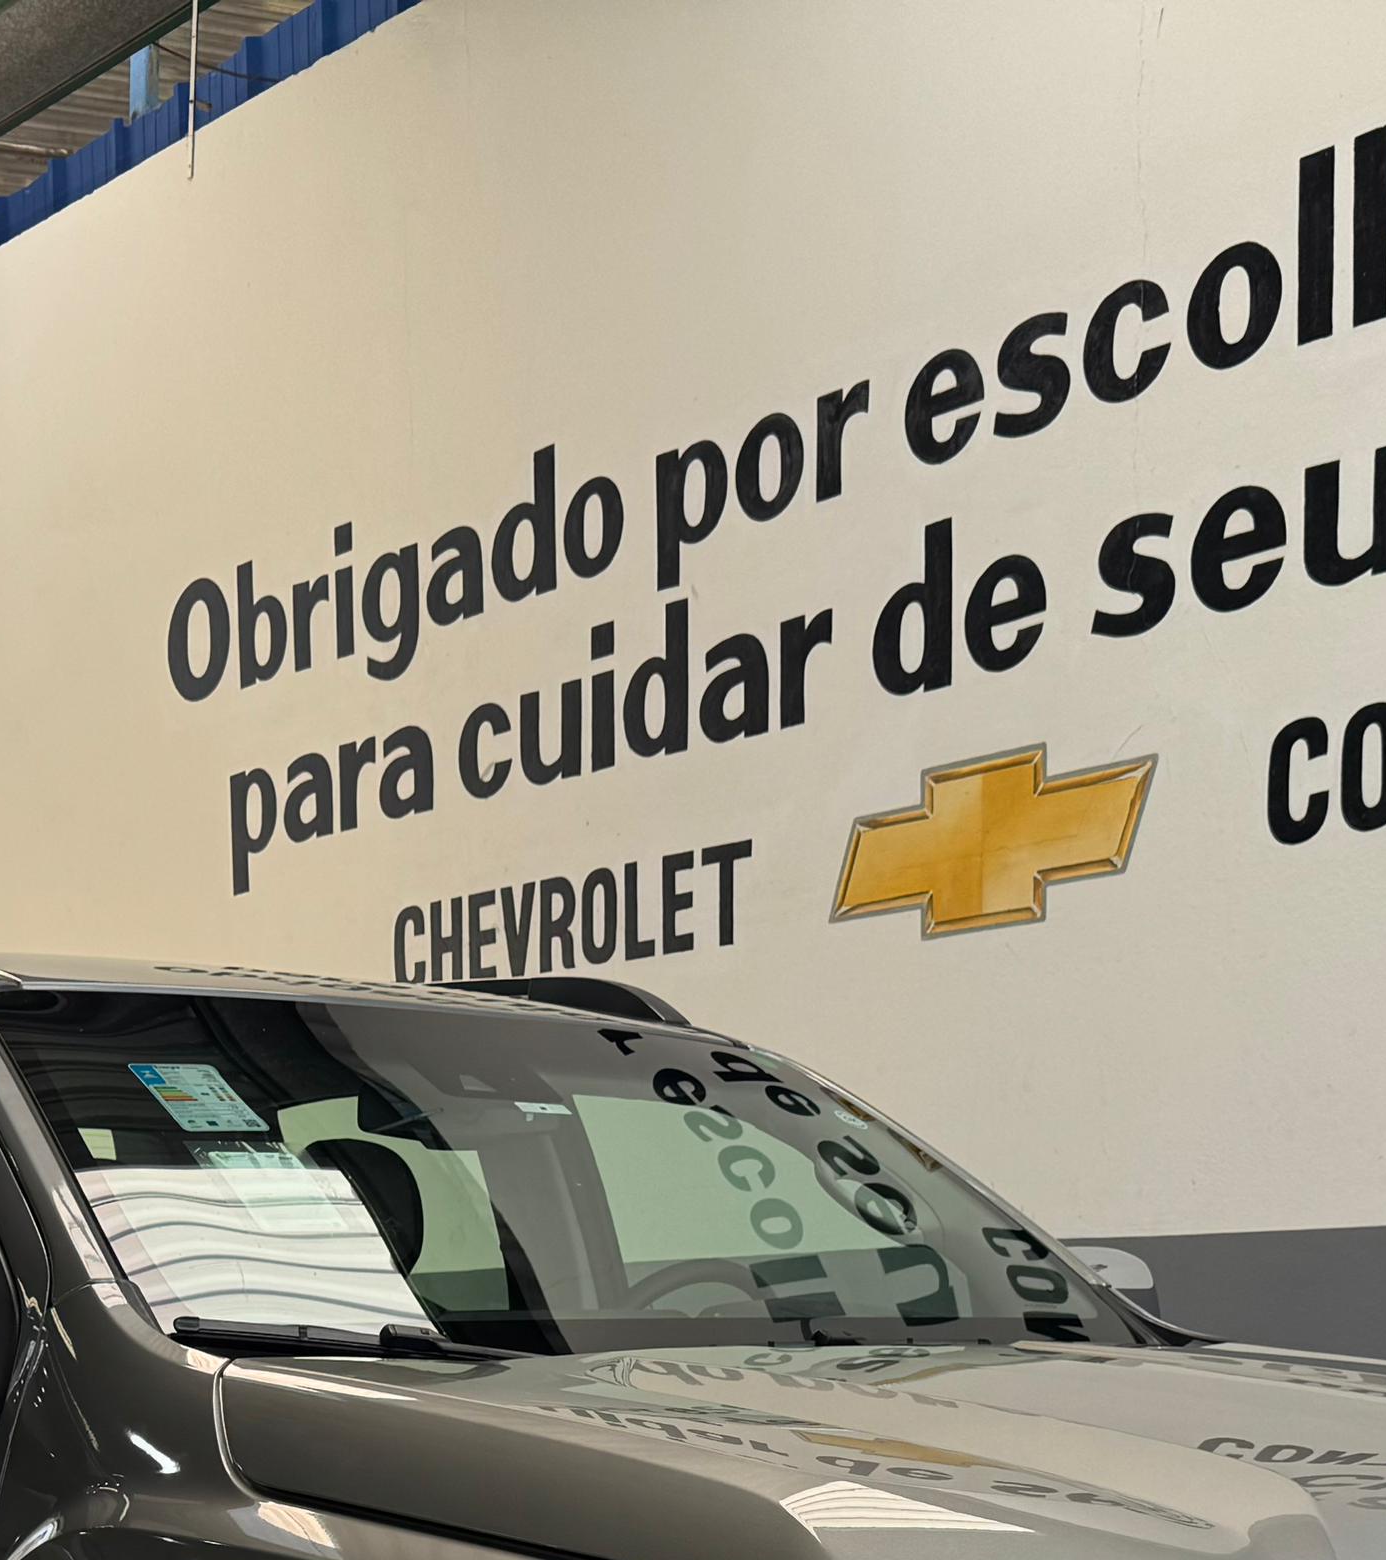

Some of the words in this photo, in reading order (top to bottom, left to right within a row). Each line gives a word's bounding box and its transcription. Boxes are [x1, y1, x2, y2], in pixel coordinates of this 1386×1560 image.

[167, 443, 624, 702] Obrigado
[655, 379, 870, 592] por
[229, 725, 434, 896] para
[458, 597, 833, 799] cuidar
[872, 516, 1047, 696] de
[394, 838, 753, 985] CHEVROLET
